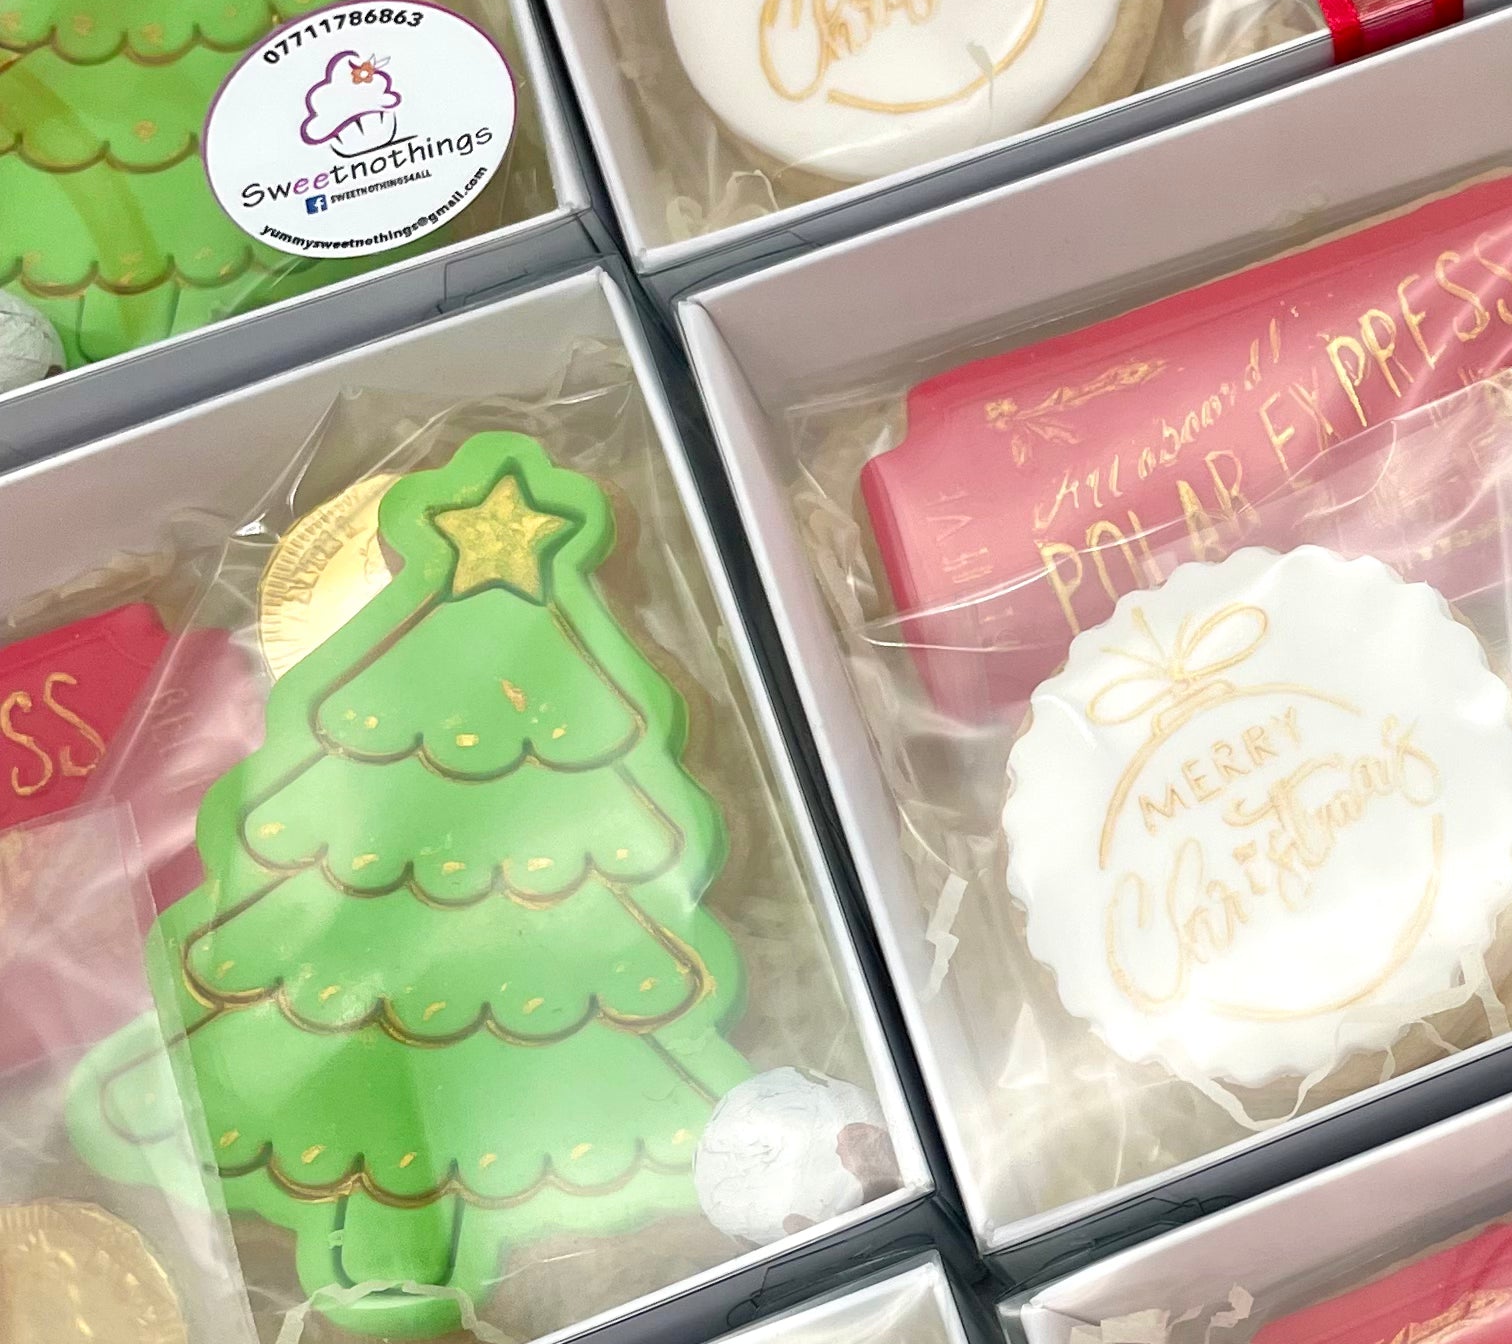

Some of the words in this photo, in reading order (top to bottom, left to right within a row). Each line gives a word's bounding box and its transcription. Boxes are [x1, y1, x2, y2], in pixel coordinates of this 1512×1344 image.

[263, 8, 424, 65] 07711786863
[241, 126, 493, 208] Sweetnothings
[259, 166, 488, 251] yummysweetnothings@gmail.com
[330, 169, 432, 204] SWEETNOTHINGS4ALL
[1138, 708, 1306, 839] MERRY
[1101, 714, 1446, 1014] Christmas
